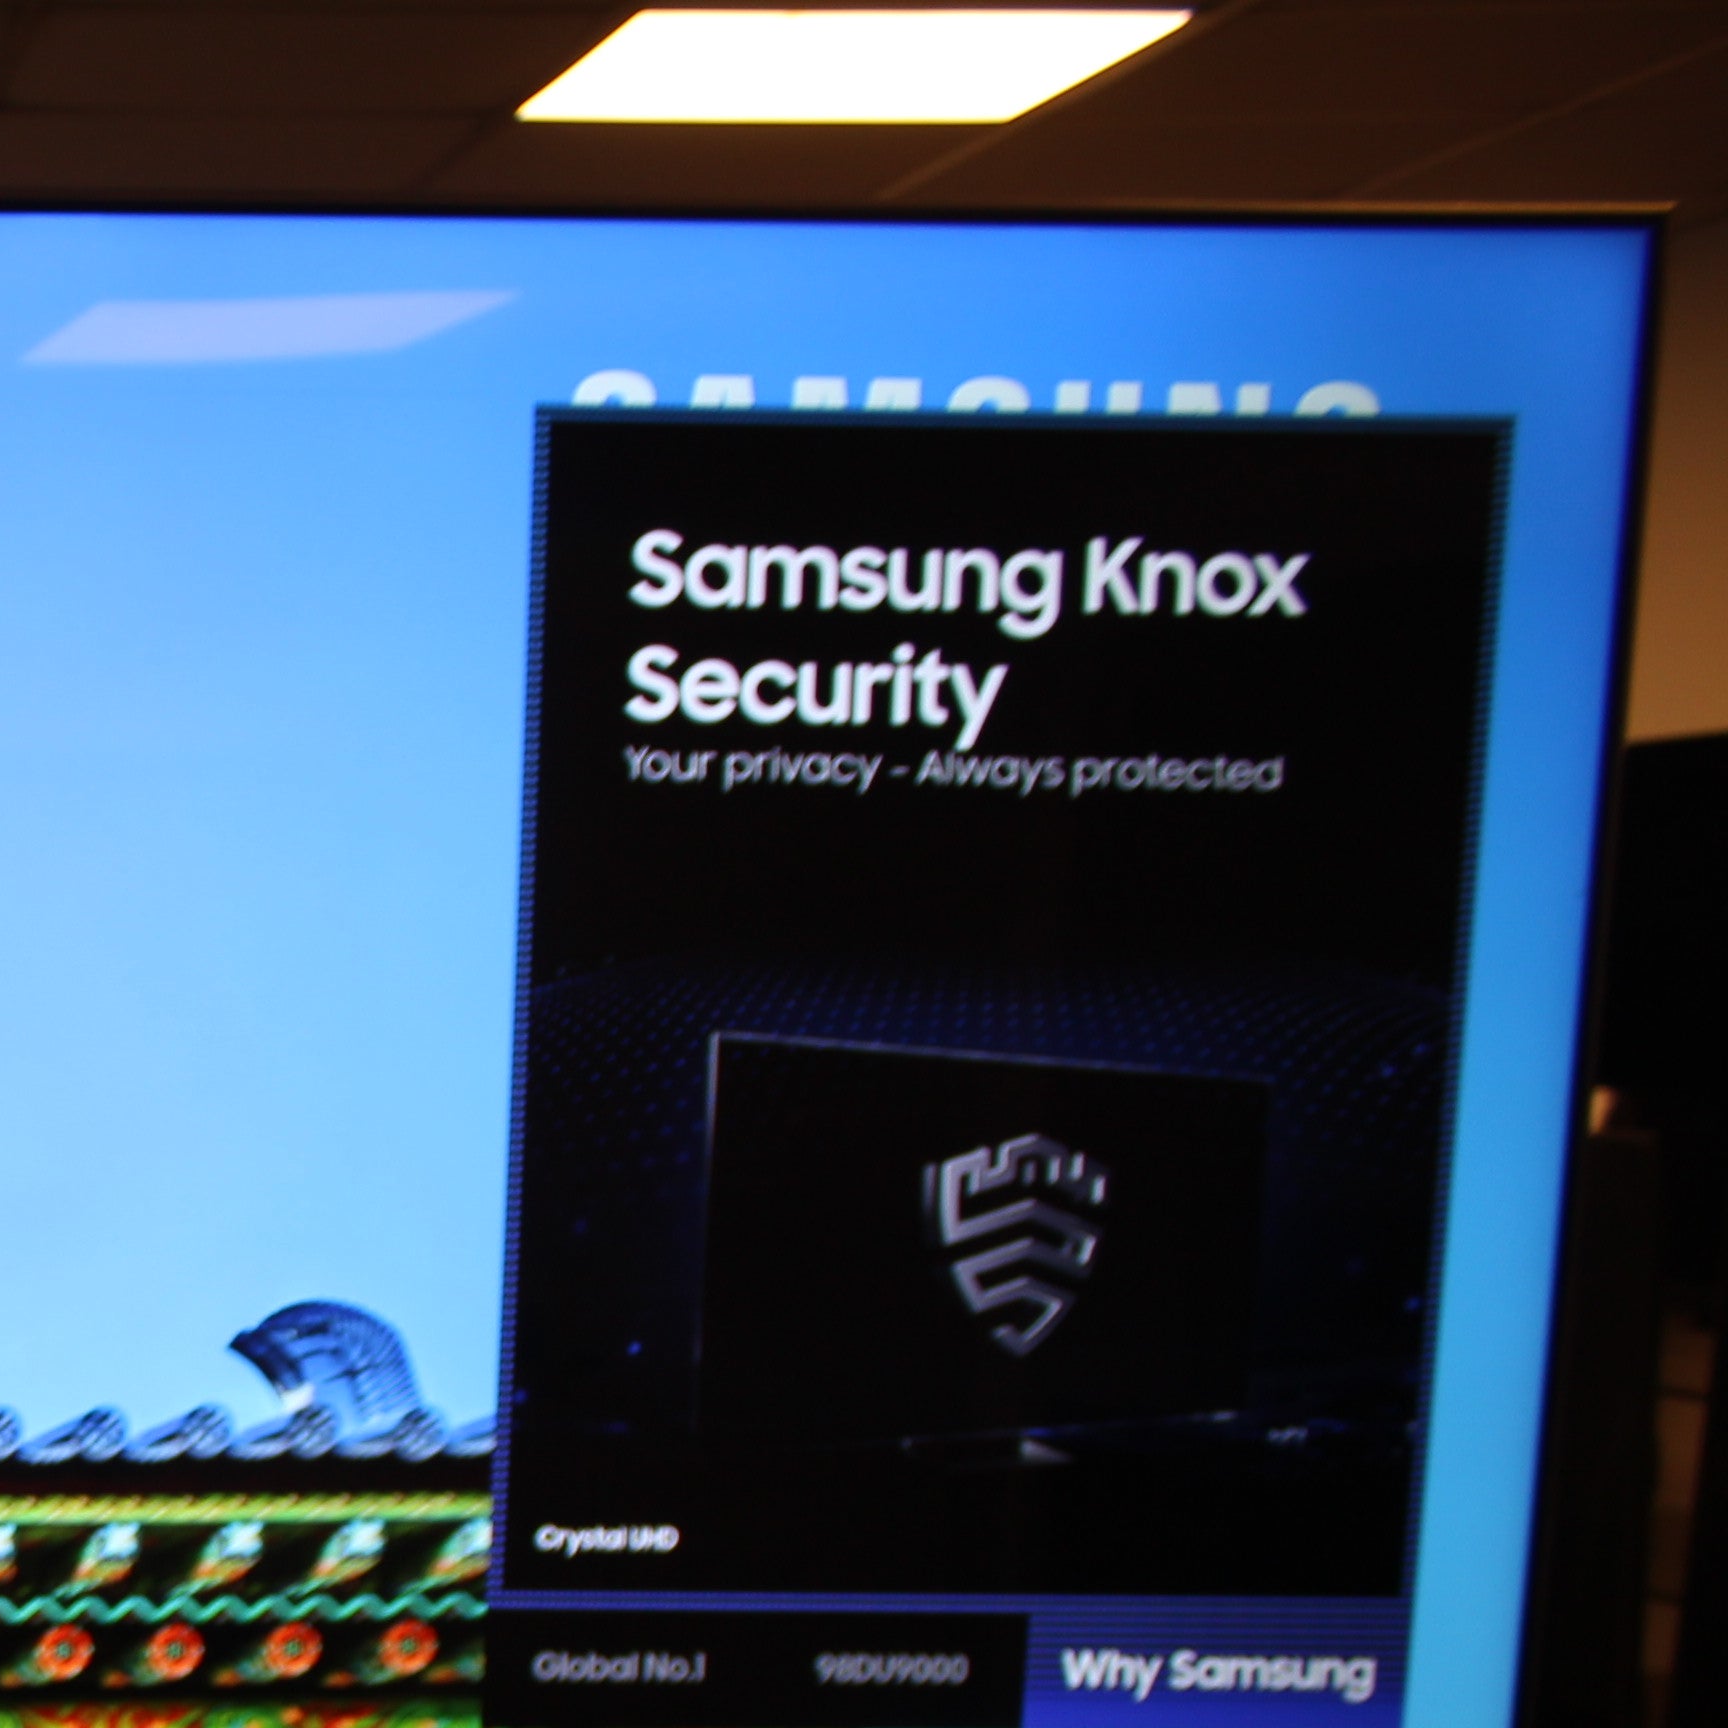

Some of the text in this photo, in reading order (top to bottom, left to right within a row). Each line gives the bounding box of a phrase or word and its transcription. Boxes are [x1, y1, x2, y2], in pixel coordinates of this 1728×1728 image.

[628, 528, 1312, 638] Samsung Knox
[623, 643, 1008, 750] Security
[623, 743, 716, 786] Your
[722, 744, 882, 793] privacy
[914, 750, 1065, 794] Always
[1070, 755, 1286, 799] protected
[534, 1524, 628, 1558] Crystal
[532, 1651, 641, 1684] Global
[1061, 1648, 1380, 1705] Why Samsung
